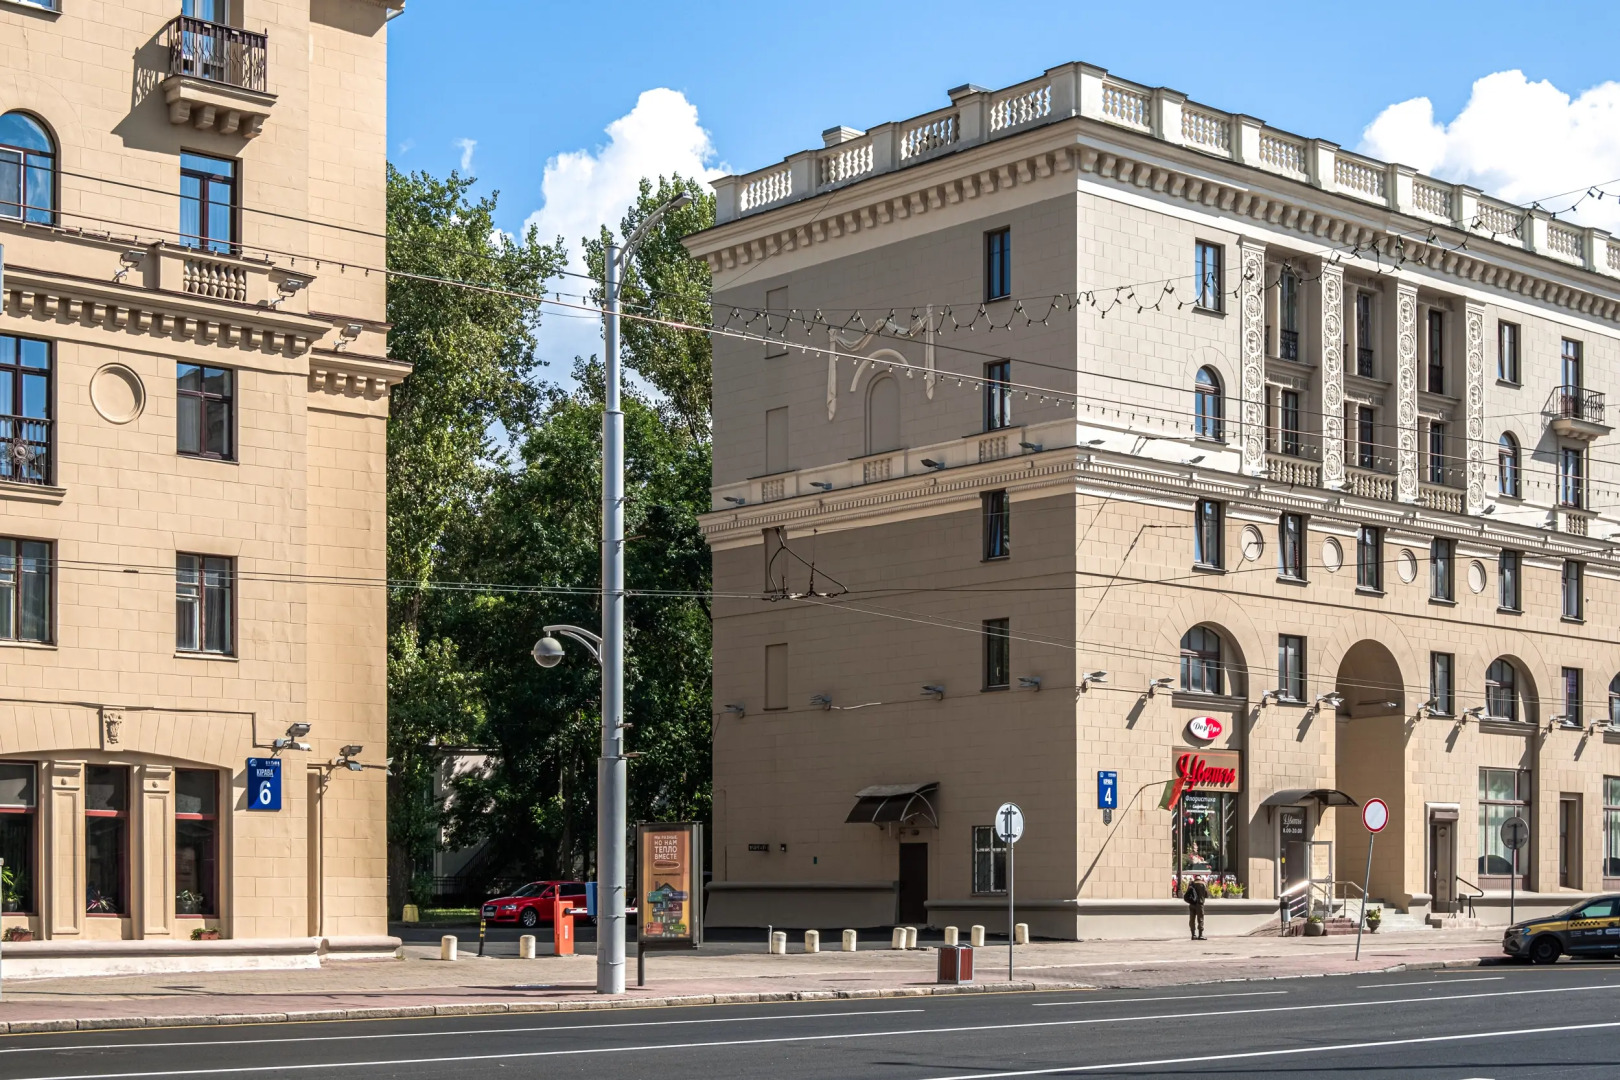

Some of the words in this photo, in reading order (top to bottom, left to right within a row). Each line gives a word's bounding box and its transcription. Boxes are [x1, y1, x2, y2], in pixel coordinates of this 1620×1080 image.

[1177, 754, 1235, 792] Цветы
[260, 780, 271, 804] 6
[1105, 787, 1112, 804] 4
